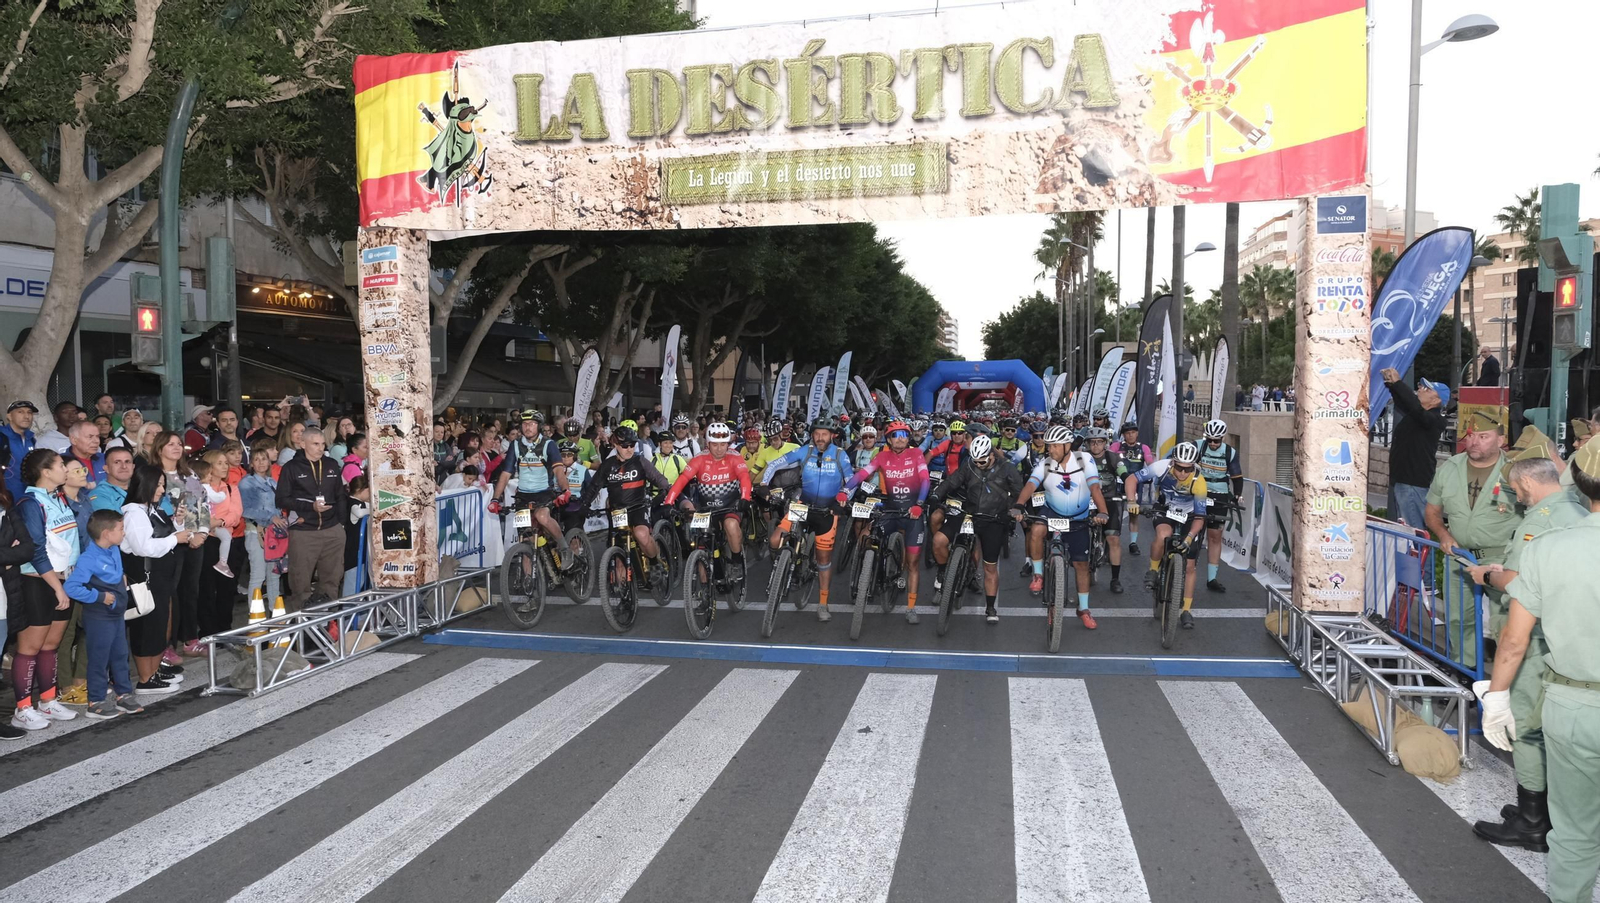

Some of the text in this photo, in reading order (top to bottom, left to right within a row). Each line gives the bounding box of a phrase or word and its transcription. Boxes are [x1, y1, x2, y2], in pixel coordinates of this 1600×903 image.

[512, 33, 1120, 141] LA DESÉRTICA
[688, 162, 916, 190] La Legión y el desierto nos une
[1419, 260, 1458, 309] JUEGA
[1317, 285, 1364, 297] RENTA
[368, 344, 397, 355] BBVA
[1110, 367, 1130, 419] HYUNDAI
[1314, 409, 1364, 419] primaflor
[1325, 474, 1351, 482] Activa
[1050, 519, 1068, 527] 10093
[1320, 545, 1354, 553] Fundación
[24, 659, 36, 694] Kalenji
